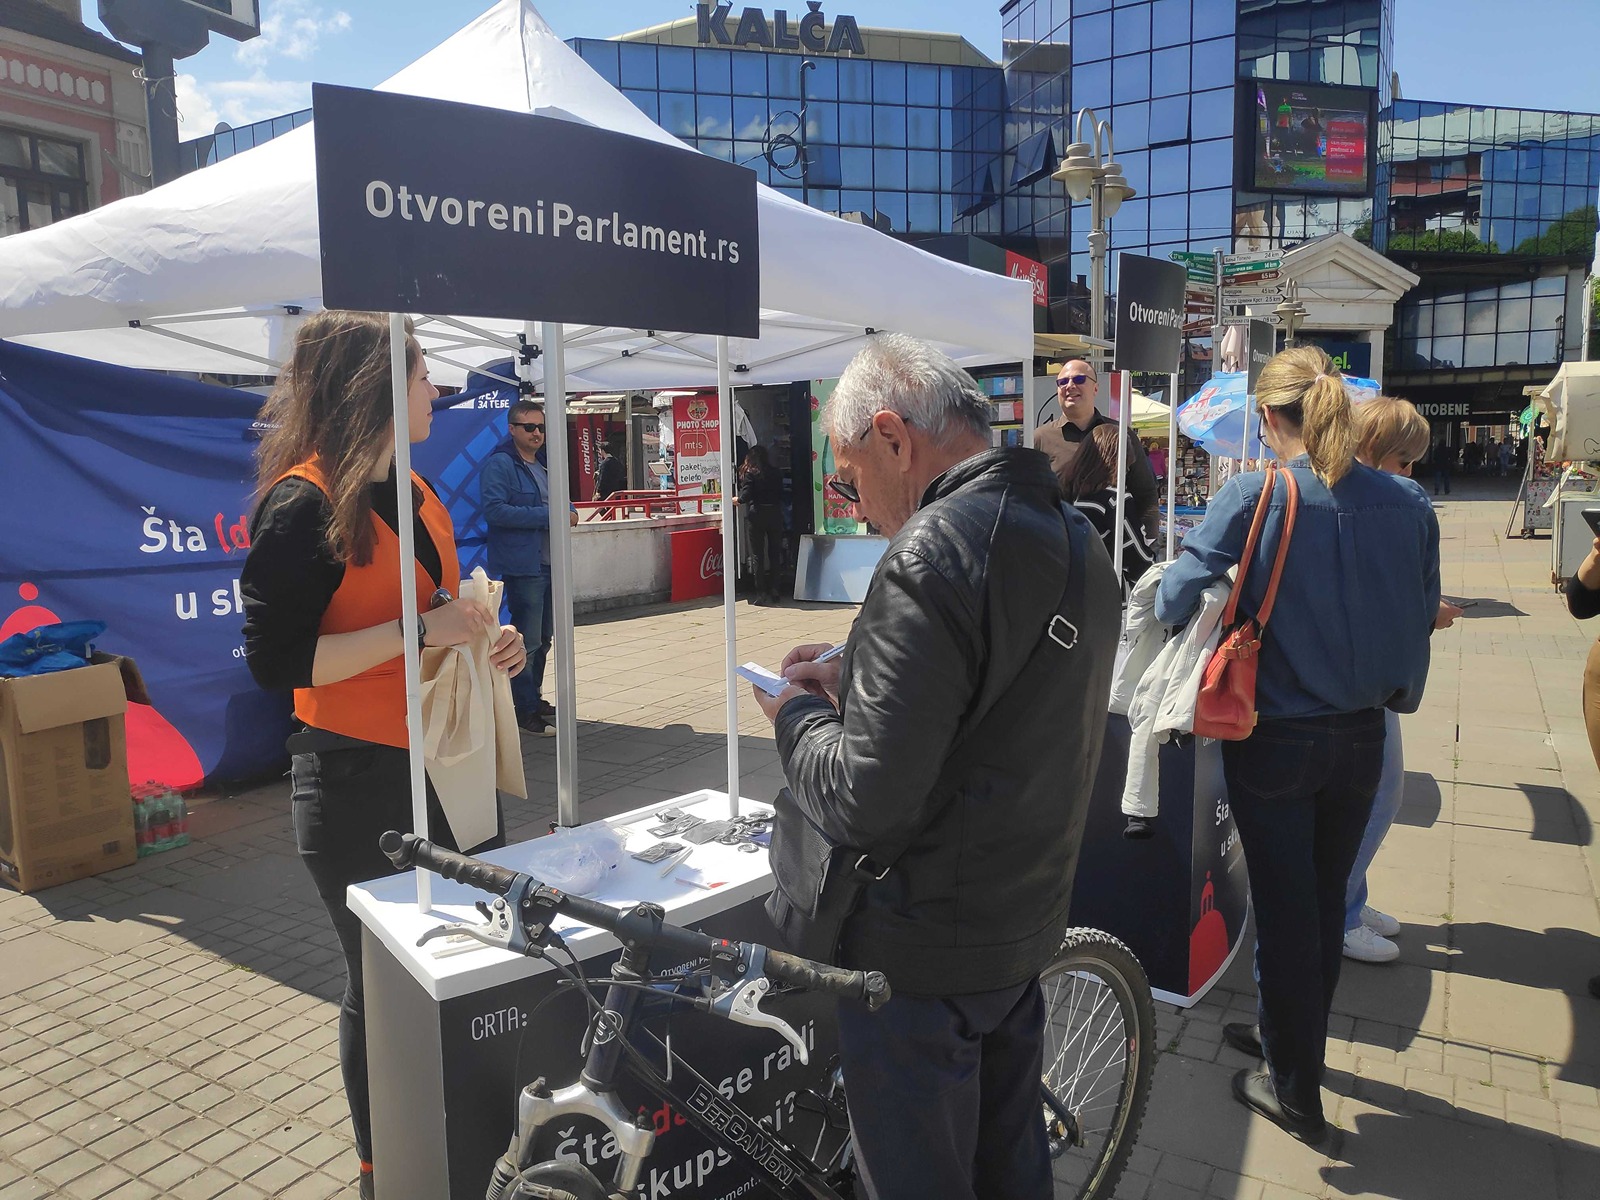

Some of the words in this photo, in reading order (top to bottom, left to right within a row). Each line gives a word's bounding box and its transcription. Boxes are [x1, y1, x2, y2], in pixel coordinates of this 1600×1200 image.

[697, 1, 865, 54] KALČA
[365, 180, 740, 264] OtvoreniParlament.rs
[478, 400, 488, 409] ЗА
[489, 399, 510, 409] ТЕБЕ
[676, 420, 700, 430] PHOTO
[702, 420, 720, 429] SHOP
[578, 427, 592, 476] meridian
[139, 505, 208, 554] Šta
[175, 591, 198, 620] u
[1215, 798, 1229, 826] Šta
[1220, 841, 1226, 857] u
[471, 1006, 528, 1041] CRTA:
[554, 1125, 622, 1167] Šta
